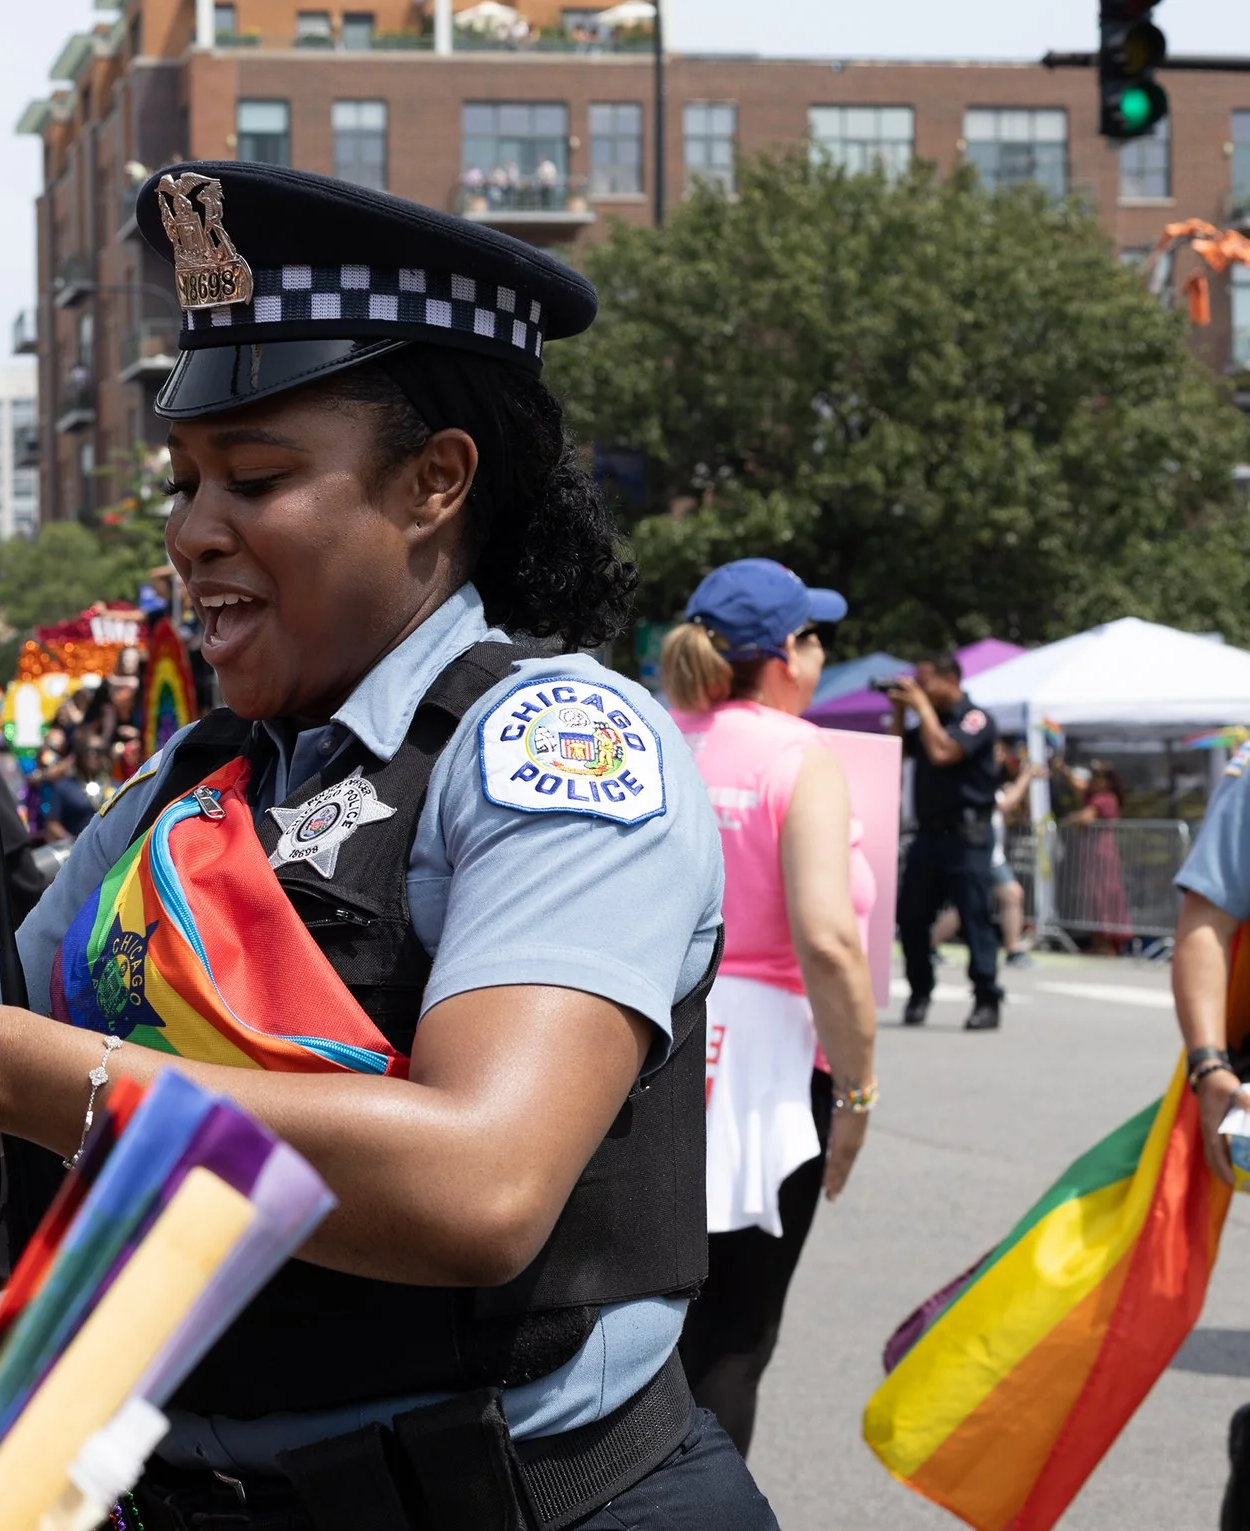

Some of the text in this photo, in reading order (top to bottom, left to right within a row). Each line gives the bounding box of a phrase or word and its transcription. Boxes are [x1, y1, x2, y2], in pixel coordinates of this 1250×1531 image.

[500, 686, 646, 752] CHICAGO
[344, 779, 372, 797] OFFICER
[510, 761, 645, 803] POLICE
[286, 789, 360, 835] CHICAGO POLICE
[289, 845, 319, 859] 18698
[112, 934, 143, 1006] CHICAGO
